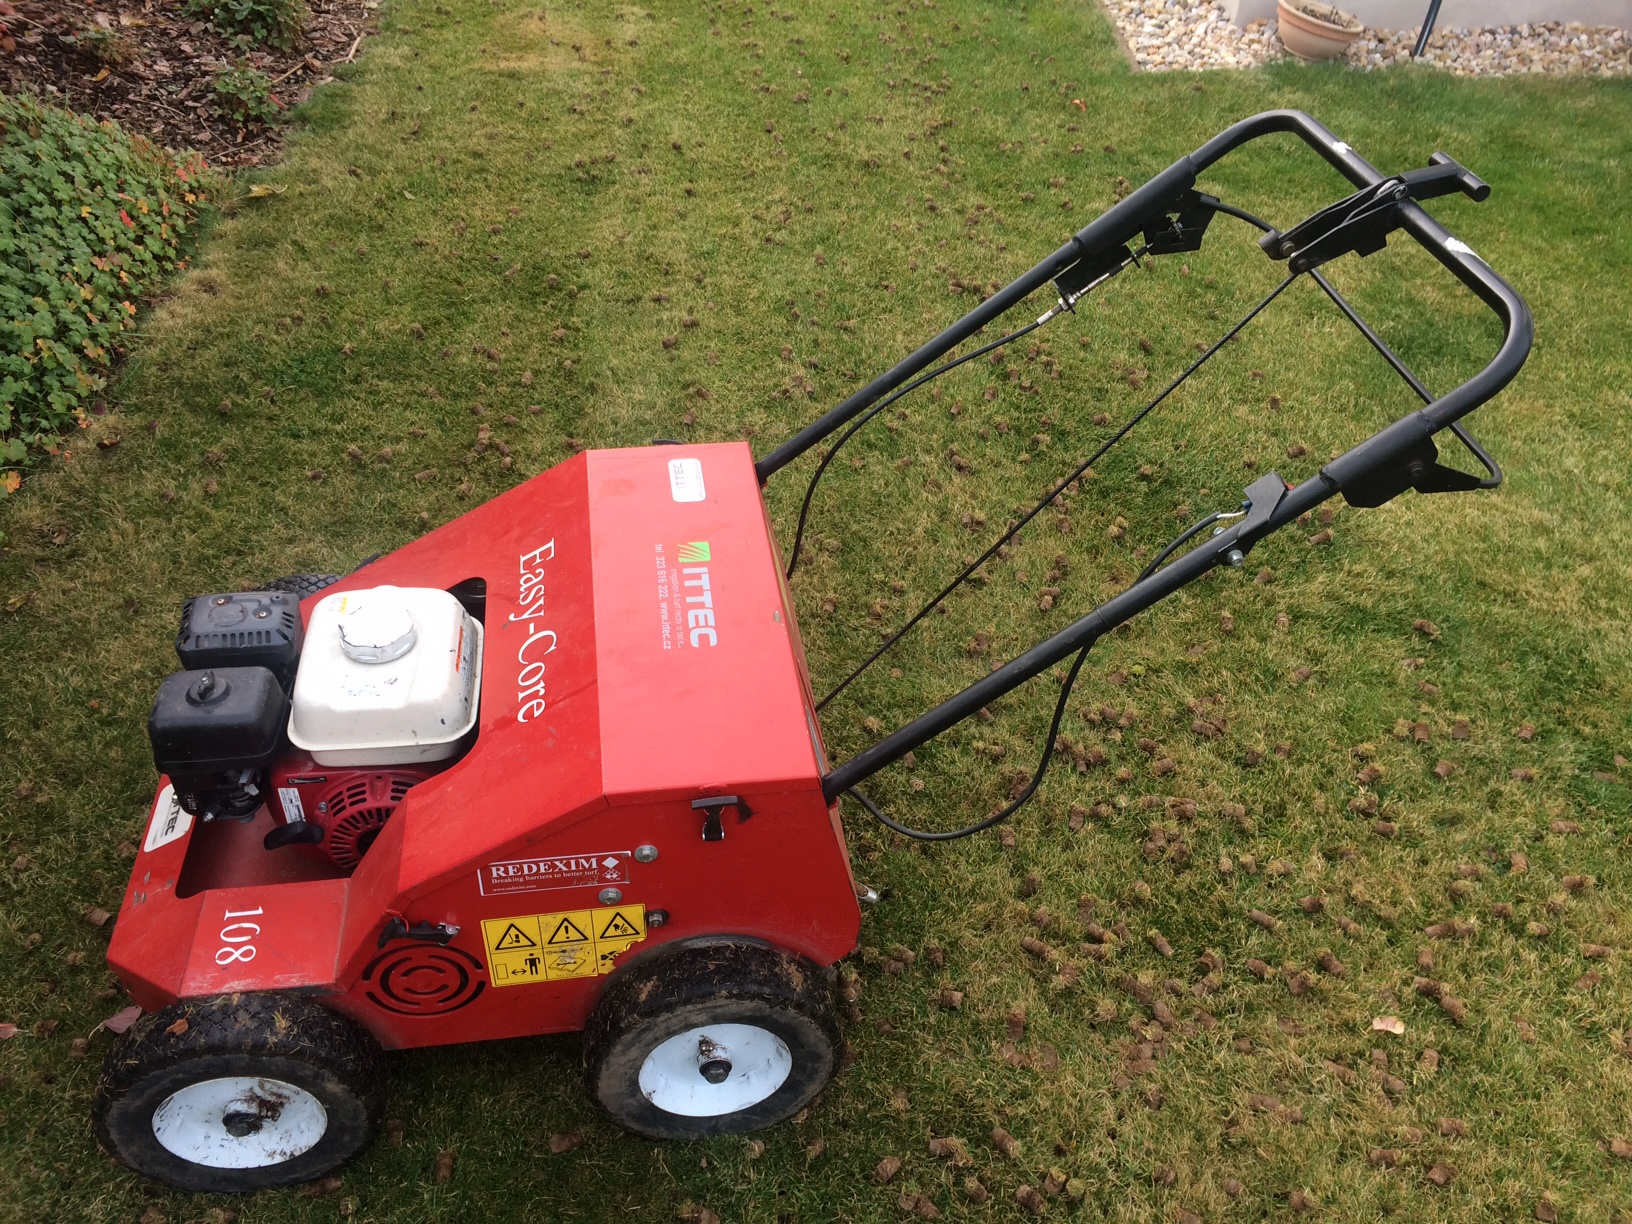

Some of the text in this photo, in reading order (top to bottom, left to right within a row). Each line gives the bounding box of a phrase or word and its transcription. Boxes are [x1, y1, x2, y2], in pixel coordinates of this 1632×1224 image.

[673, 462, 686, 490] ITTEC
[656, 556, 666, 569] 323
[657, 570, 668, 584] 616
[682, 566, 718, 649] ITTEC
[508, 537, 557, 723] Easy-Core
[660, 601, 672, 650] www.ittec.cz
[490, 857, 599, 878] REDEXIM
[491, 876, 524, 885] Breaking
[525, 872, 553, 881] barriers
[563, 870, 583, 878] better
[215, 905, 264, 965] 108
